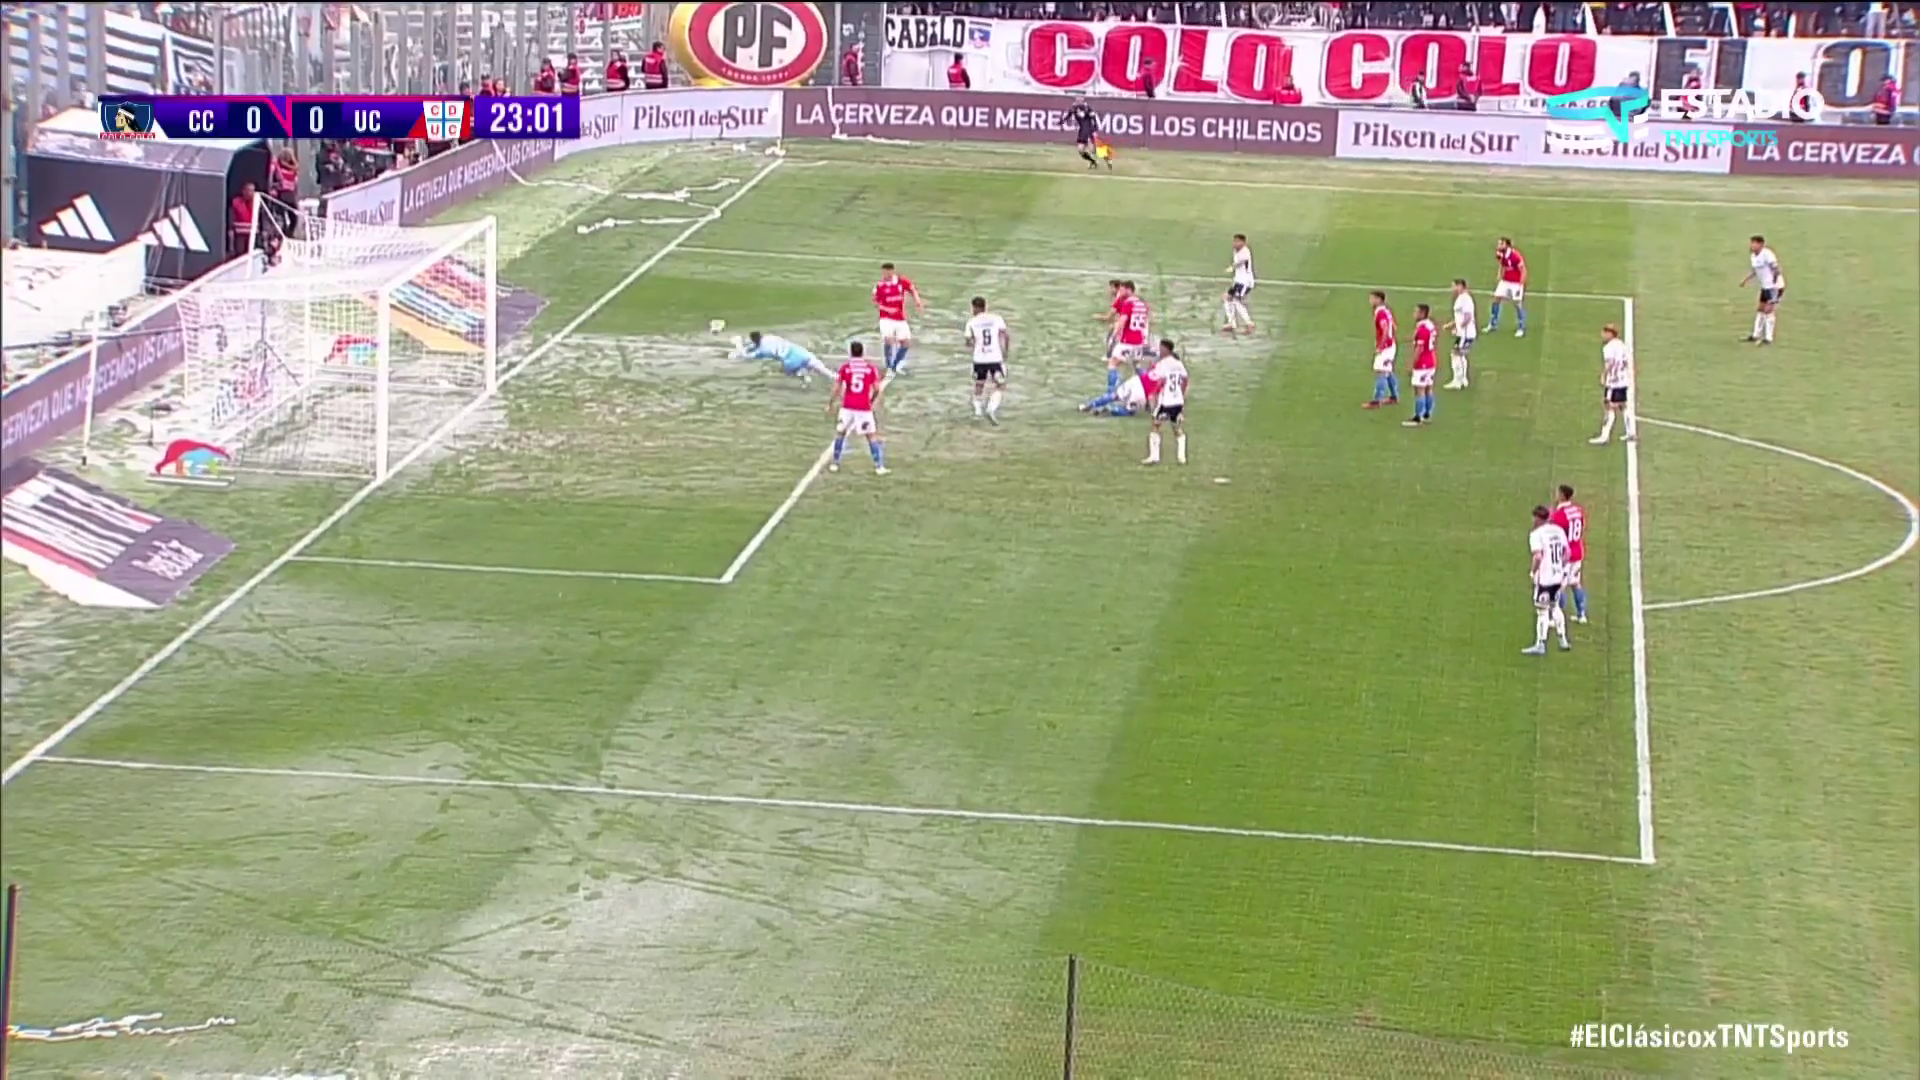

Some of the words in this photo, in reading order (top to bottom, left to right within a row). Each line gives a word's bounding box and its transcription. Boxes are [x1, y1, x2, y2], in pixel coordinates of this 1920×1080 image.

[722, 3, 792, 68] PF
[1026, 23, 1292, 101] COLO
[1324, 33, 1597, 99] COLO
[593, 114, 619, 139] Sur
[633, 105, 695, 130] Pilsen
[699, 109, 722, 127] del
[726, 105, 768, 129] Sur
[796, 103, 825, 124] LA
[829, 103, 935, 126] CERVEZA
[941, 106, 989, 128] QUE
[1150, 115, 1196, 137] LOS
[1202, 117, 1322, 143] CHILENOS
[1352, 121, 1436, 150] Pilsen
[1440, 133, 1466, 151] del
[1470, 130, 1519, 155] Sur
[1633, 141, 1660, 158] del
[1747, 141, 1780, 162] LA
[1788, 141, 1906, 166] CERVEZA
[851, 374, 864, 392] 5
[1568, 519, 1582, 542] 18
